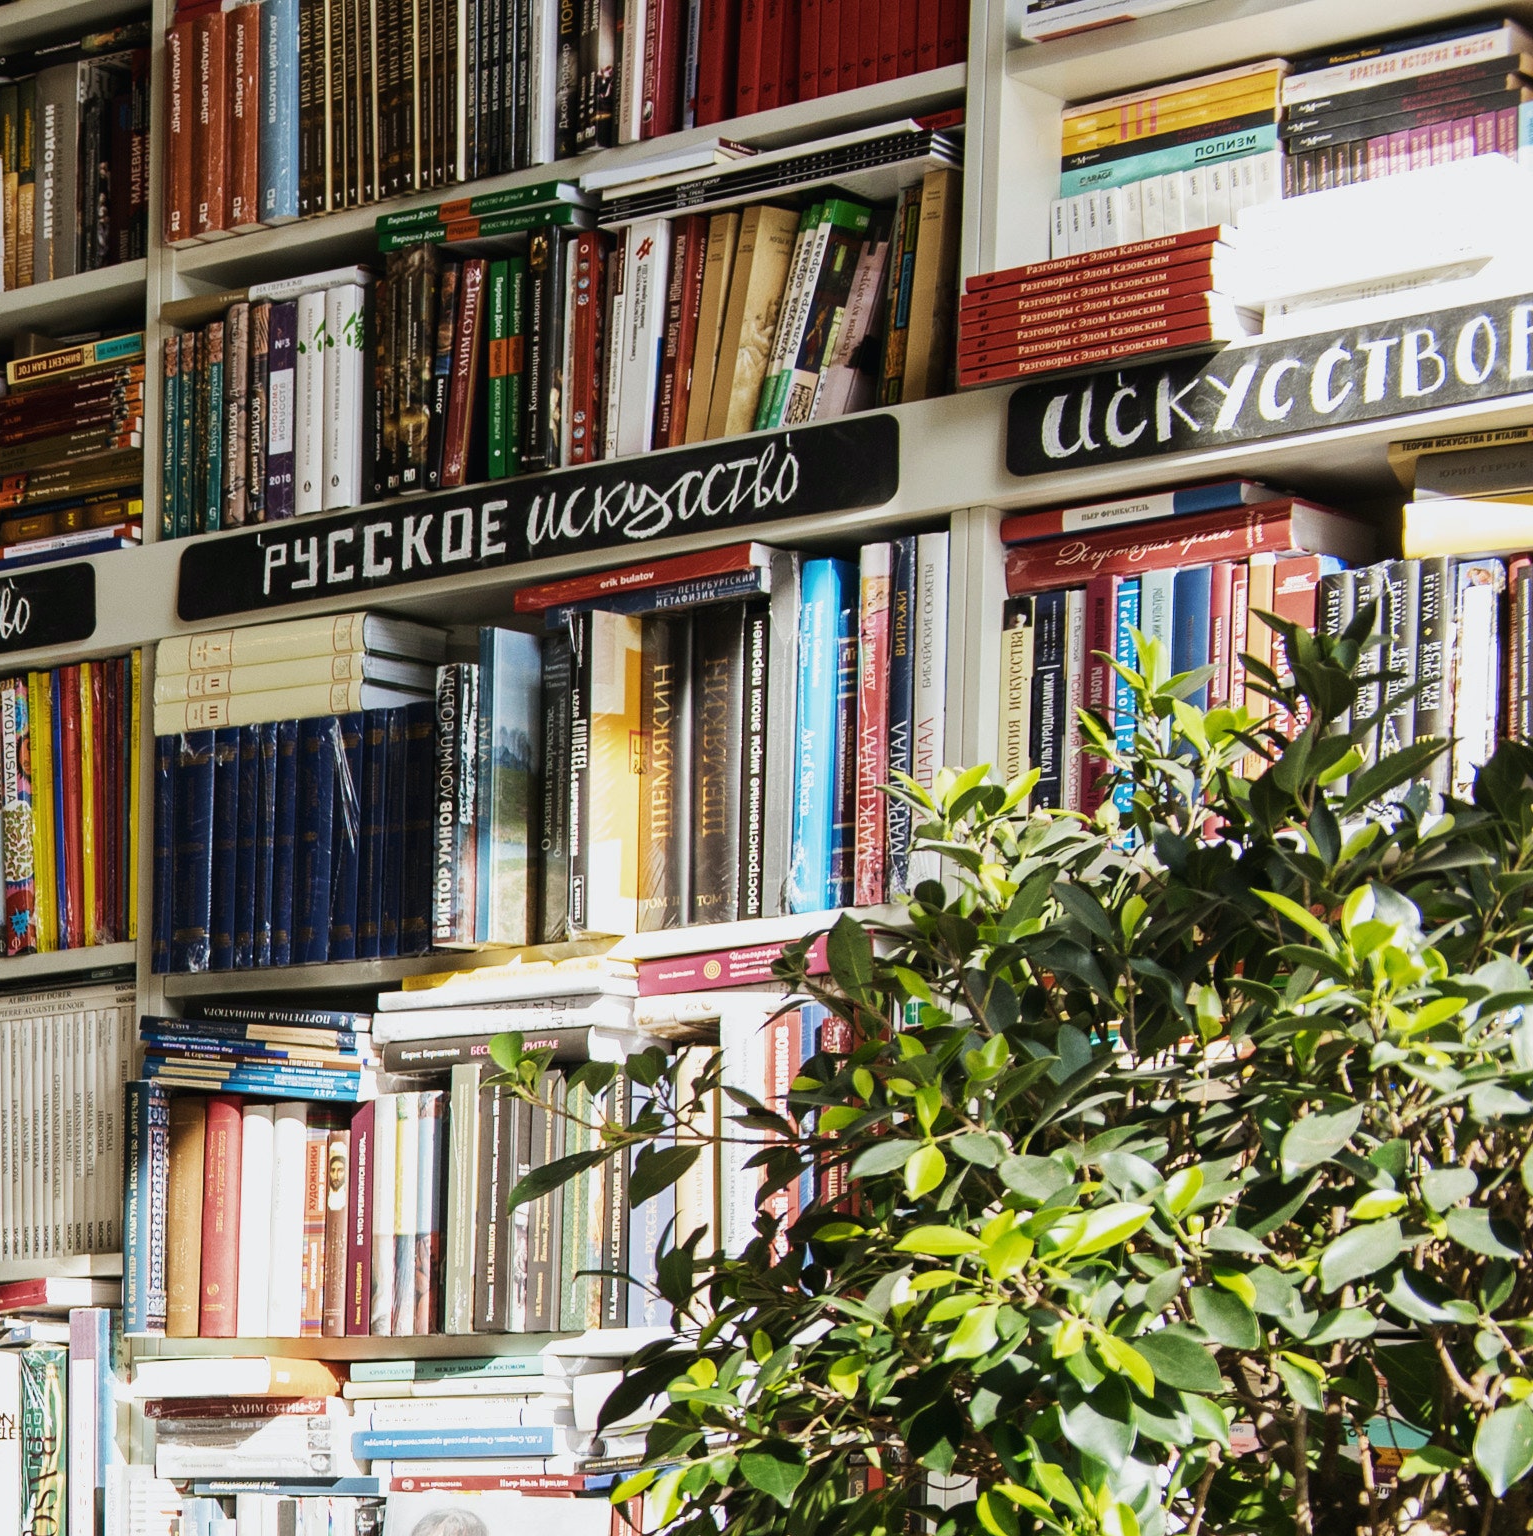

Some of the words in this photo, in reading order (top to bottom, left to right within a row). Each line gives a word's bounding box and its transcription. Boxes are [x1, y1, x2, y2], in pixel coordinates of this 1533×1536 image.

[1194, 133, 1257, 157] ПОПИЗМ
[263, 500, 508, 595] РУССКОЕ
[600, 576, 617, 589] erik
[620, 571, 654, 586] bulatov
[752, 620, 763, 695] перемен
[3, 696, 14, 738] YAYOI
[5, 742, 17, 805] KUSAMA
[437, 864, 454, 939] ВИКТОР
